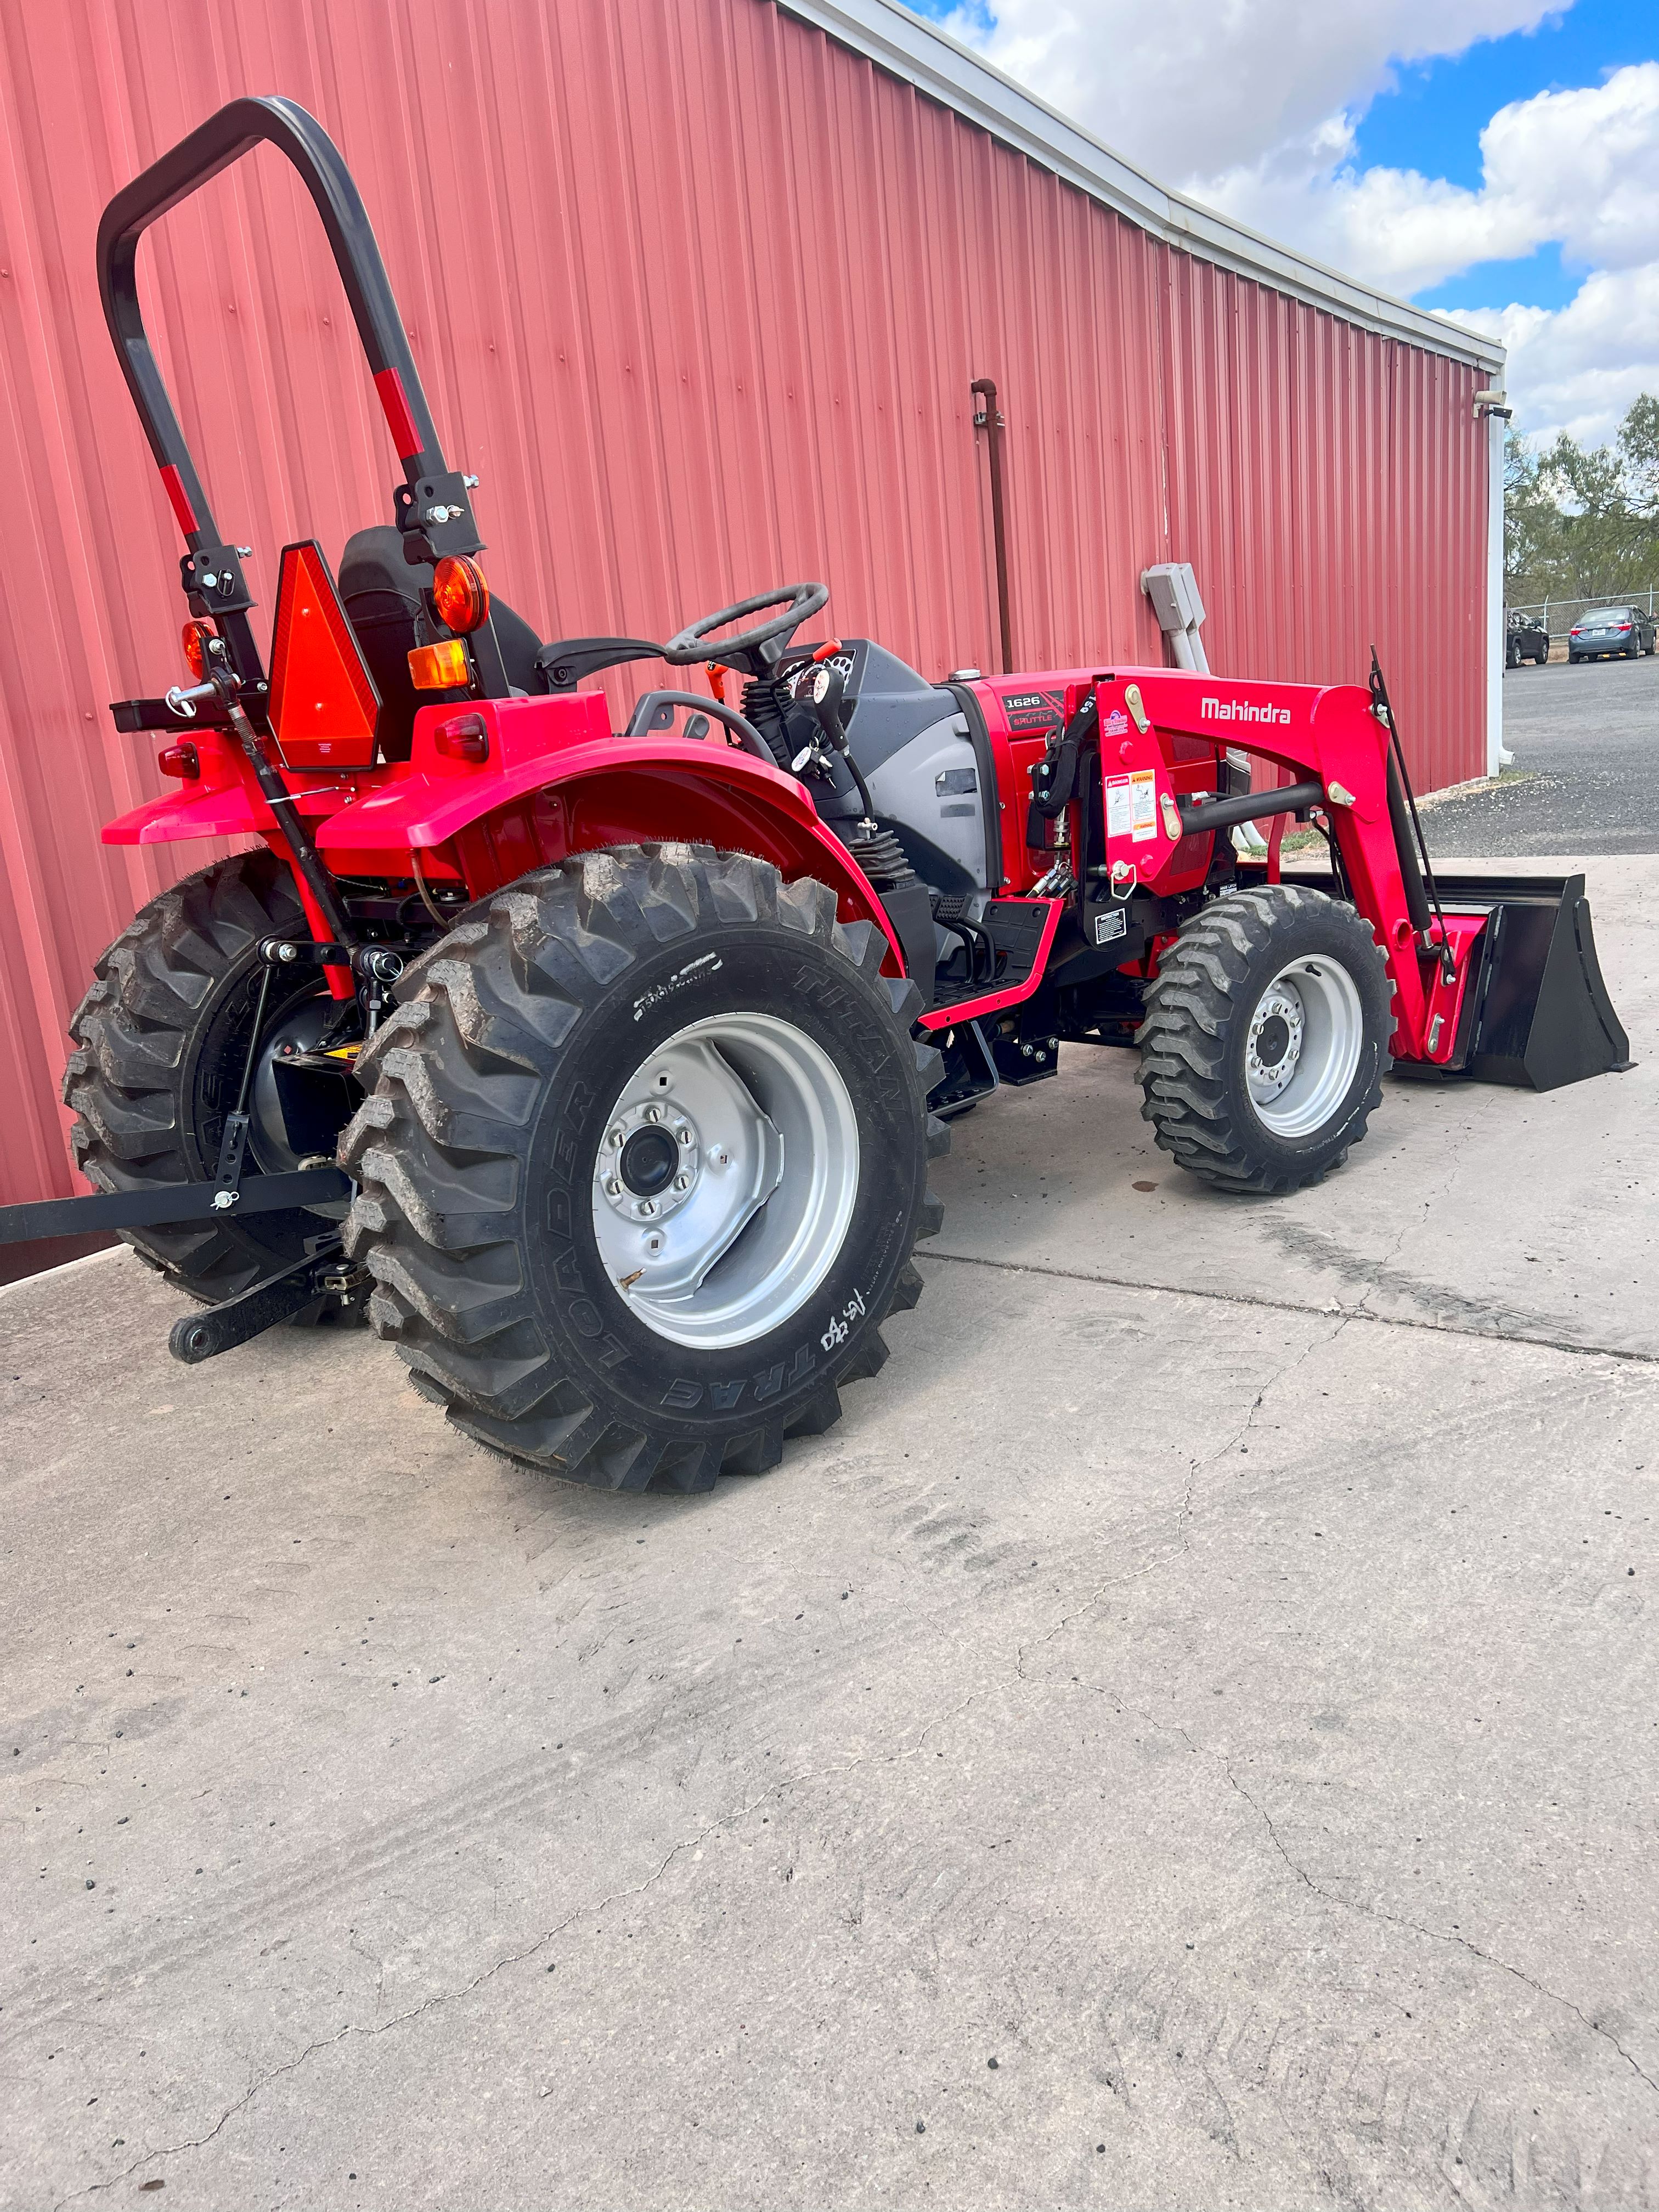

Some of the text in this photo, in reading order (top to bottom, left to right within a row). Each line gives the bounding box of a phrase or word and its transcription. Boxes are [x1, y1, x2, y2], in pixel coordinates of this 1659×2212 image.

[1007, 696, 1040, 708] 1626
[1201, 697, 1291, 724] Mahindra
[1013, 714, 1053, 725] SHUTTLE
[793, 964, 907, 1112] TITAN
[548, 1080, 816, 1410] TRAC LOADER
